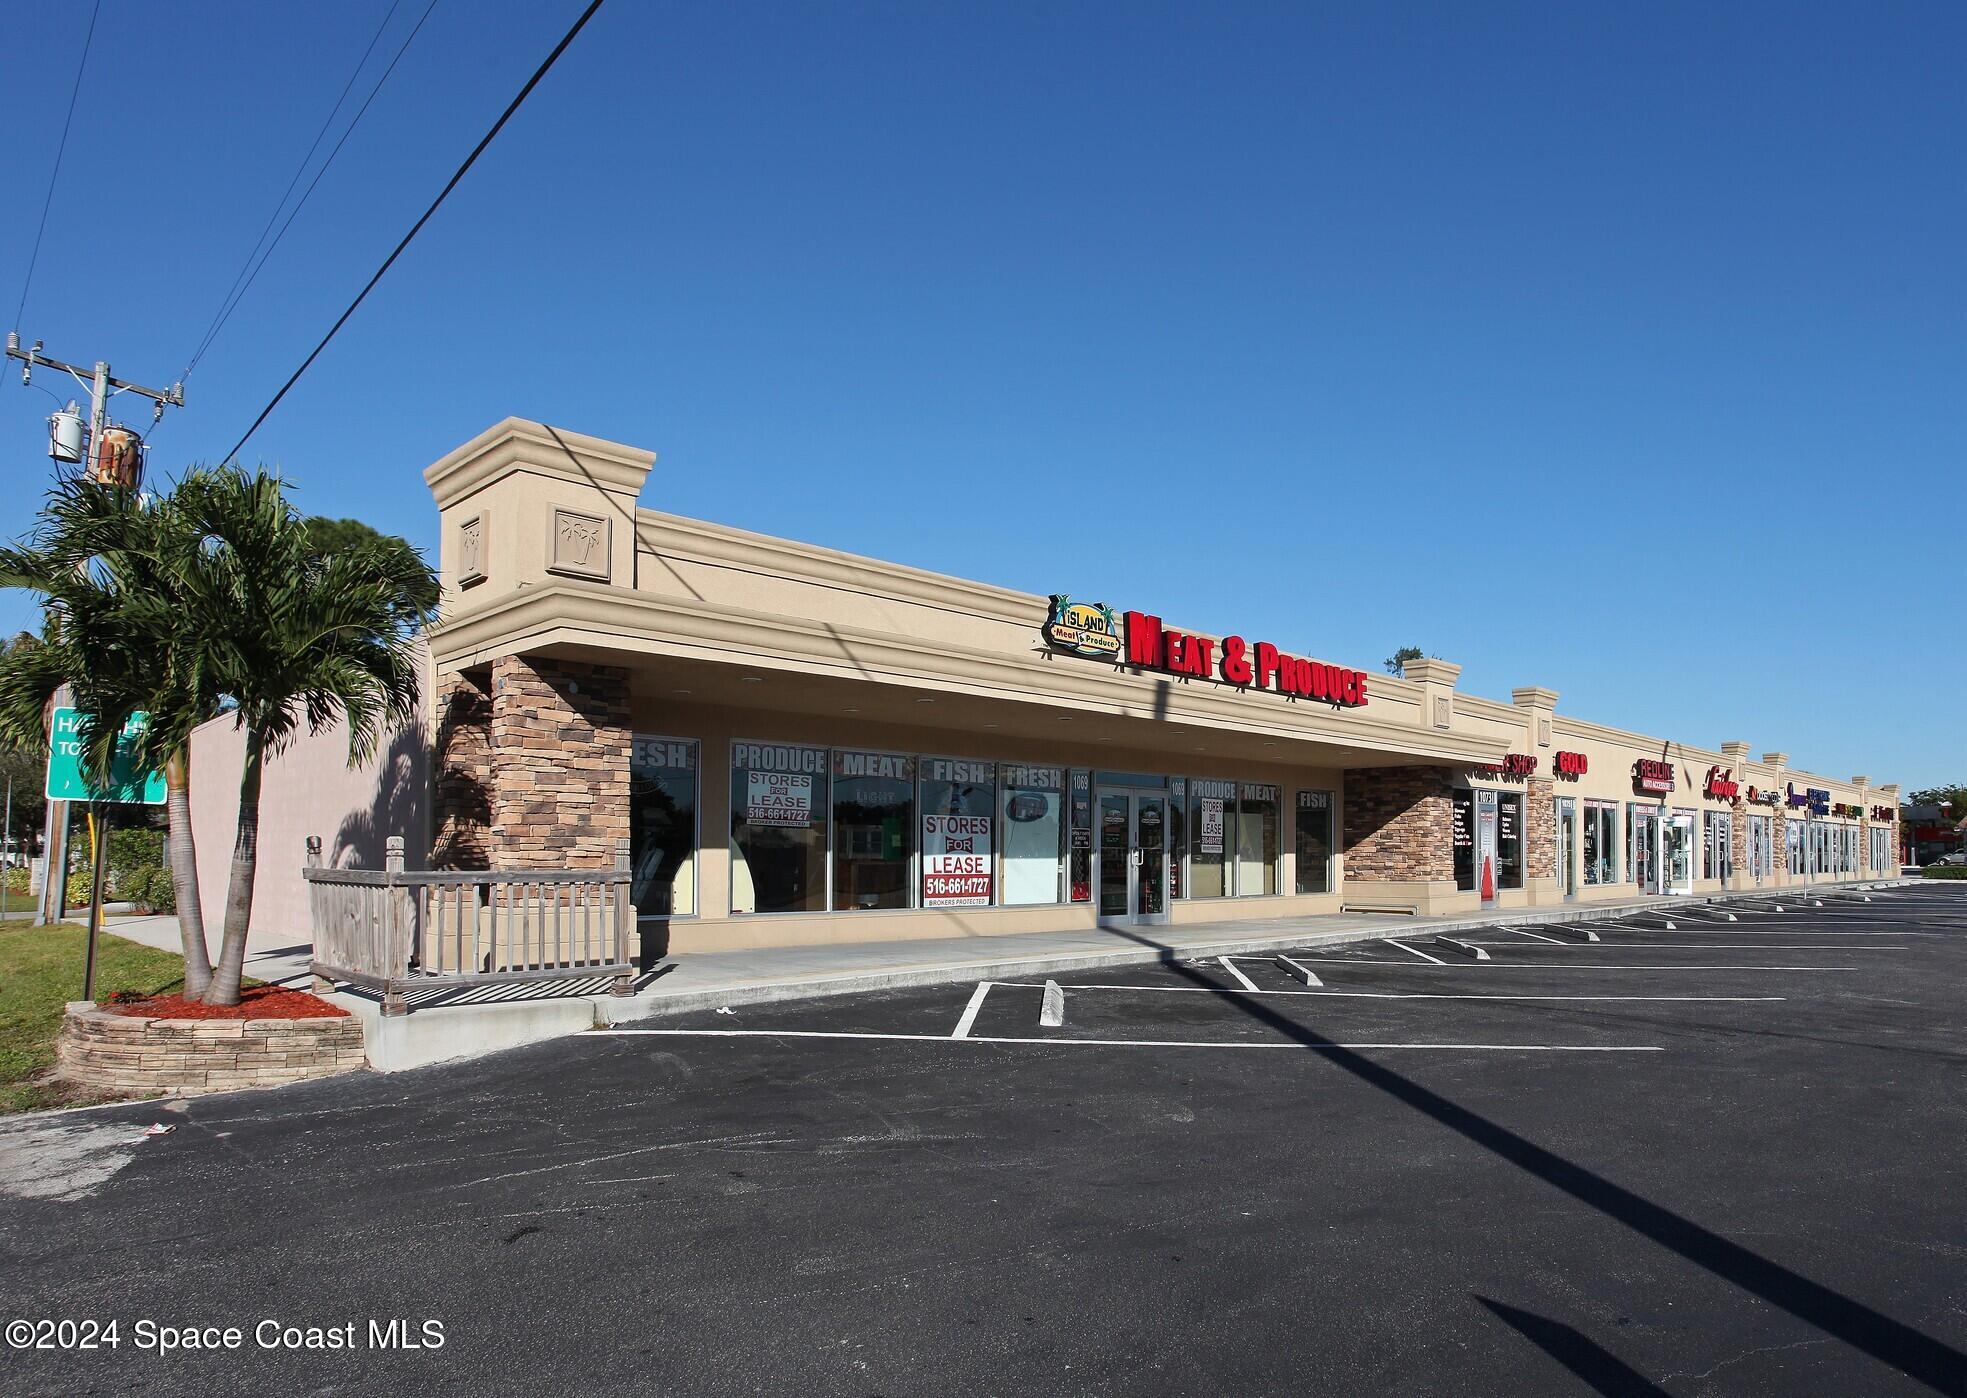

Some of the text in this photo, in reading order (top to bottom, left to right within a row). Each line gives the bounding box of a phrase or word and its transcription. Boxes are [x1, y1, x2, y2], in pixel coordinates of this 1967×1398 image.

[1067, 609, 1105, 632] iSLAND
[1056, 628, 1075, 640] Meat
[1086, 634, 1115, 648] Produce
[1220, 636, 1252, 683] &
[1254, 642, 1368, 706] PRODUCE
[735, 745, 824, 773] PRODUCE
[843, 754, 906, 778] MEAT
[1560, 751, 1587, 775] GOLD
[750, 773, 810, 788] STORES
[933, 761, 985, 783] FISH
[1007, 767, 1060, 788] FRESH
[1191, 780, 1236, 799] PRODUCE
[1244, 787, 1276, 801] MEAT
[752, 797, 806, 808] LEASE
[1202, 801, 1222, 814] STORES
[1301, 792, 1327, 808] FISH
[748, 808, 810, 821] 516-661-1727
[926, 817, 989, 835] STORES
[1203, 823, 1221, 835] LEASE
[946, 839, 972, 851] FOR
[933, 857, 983, 874] LEASE
[927, 878, 989, 895] 516-661-1727
